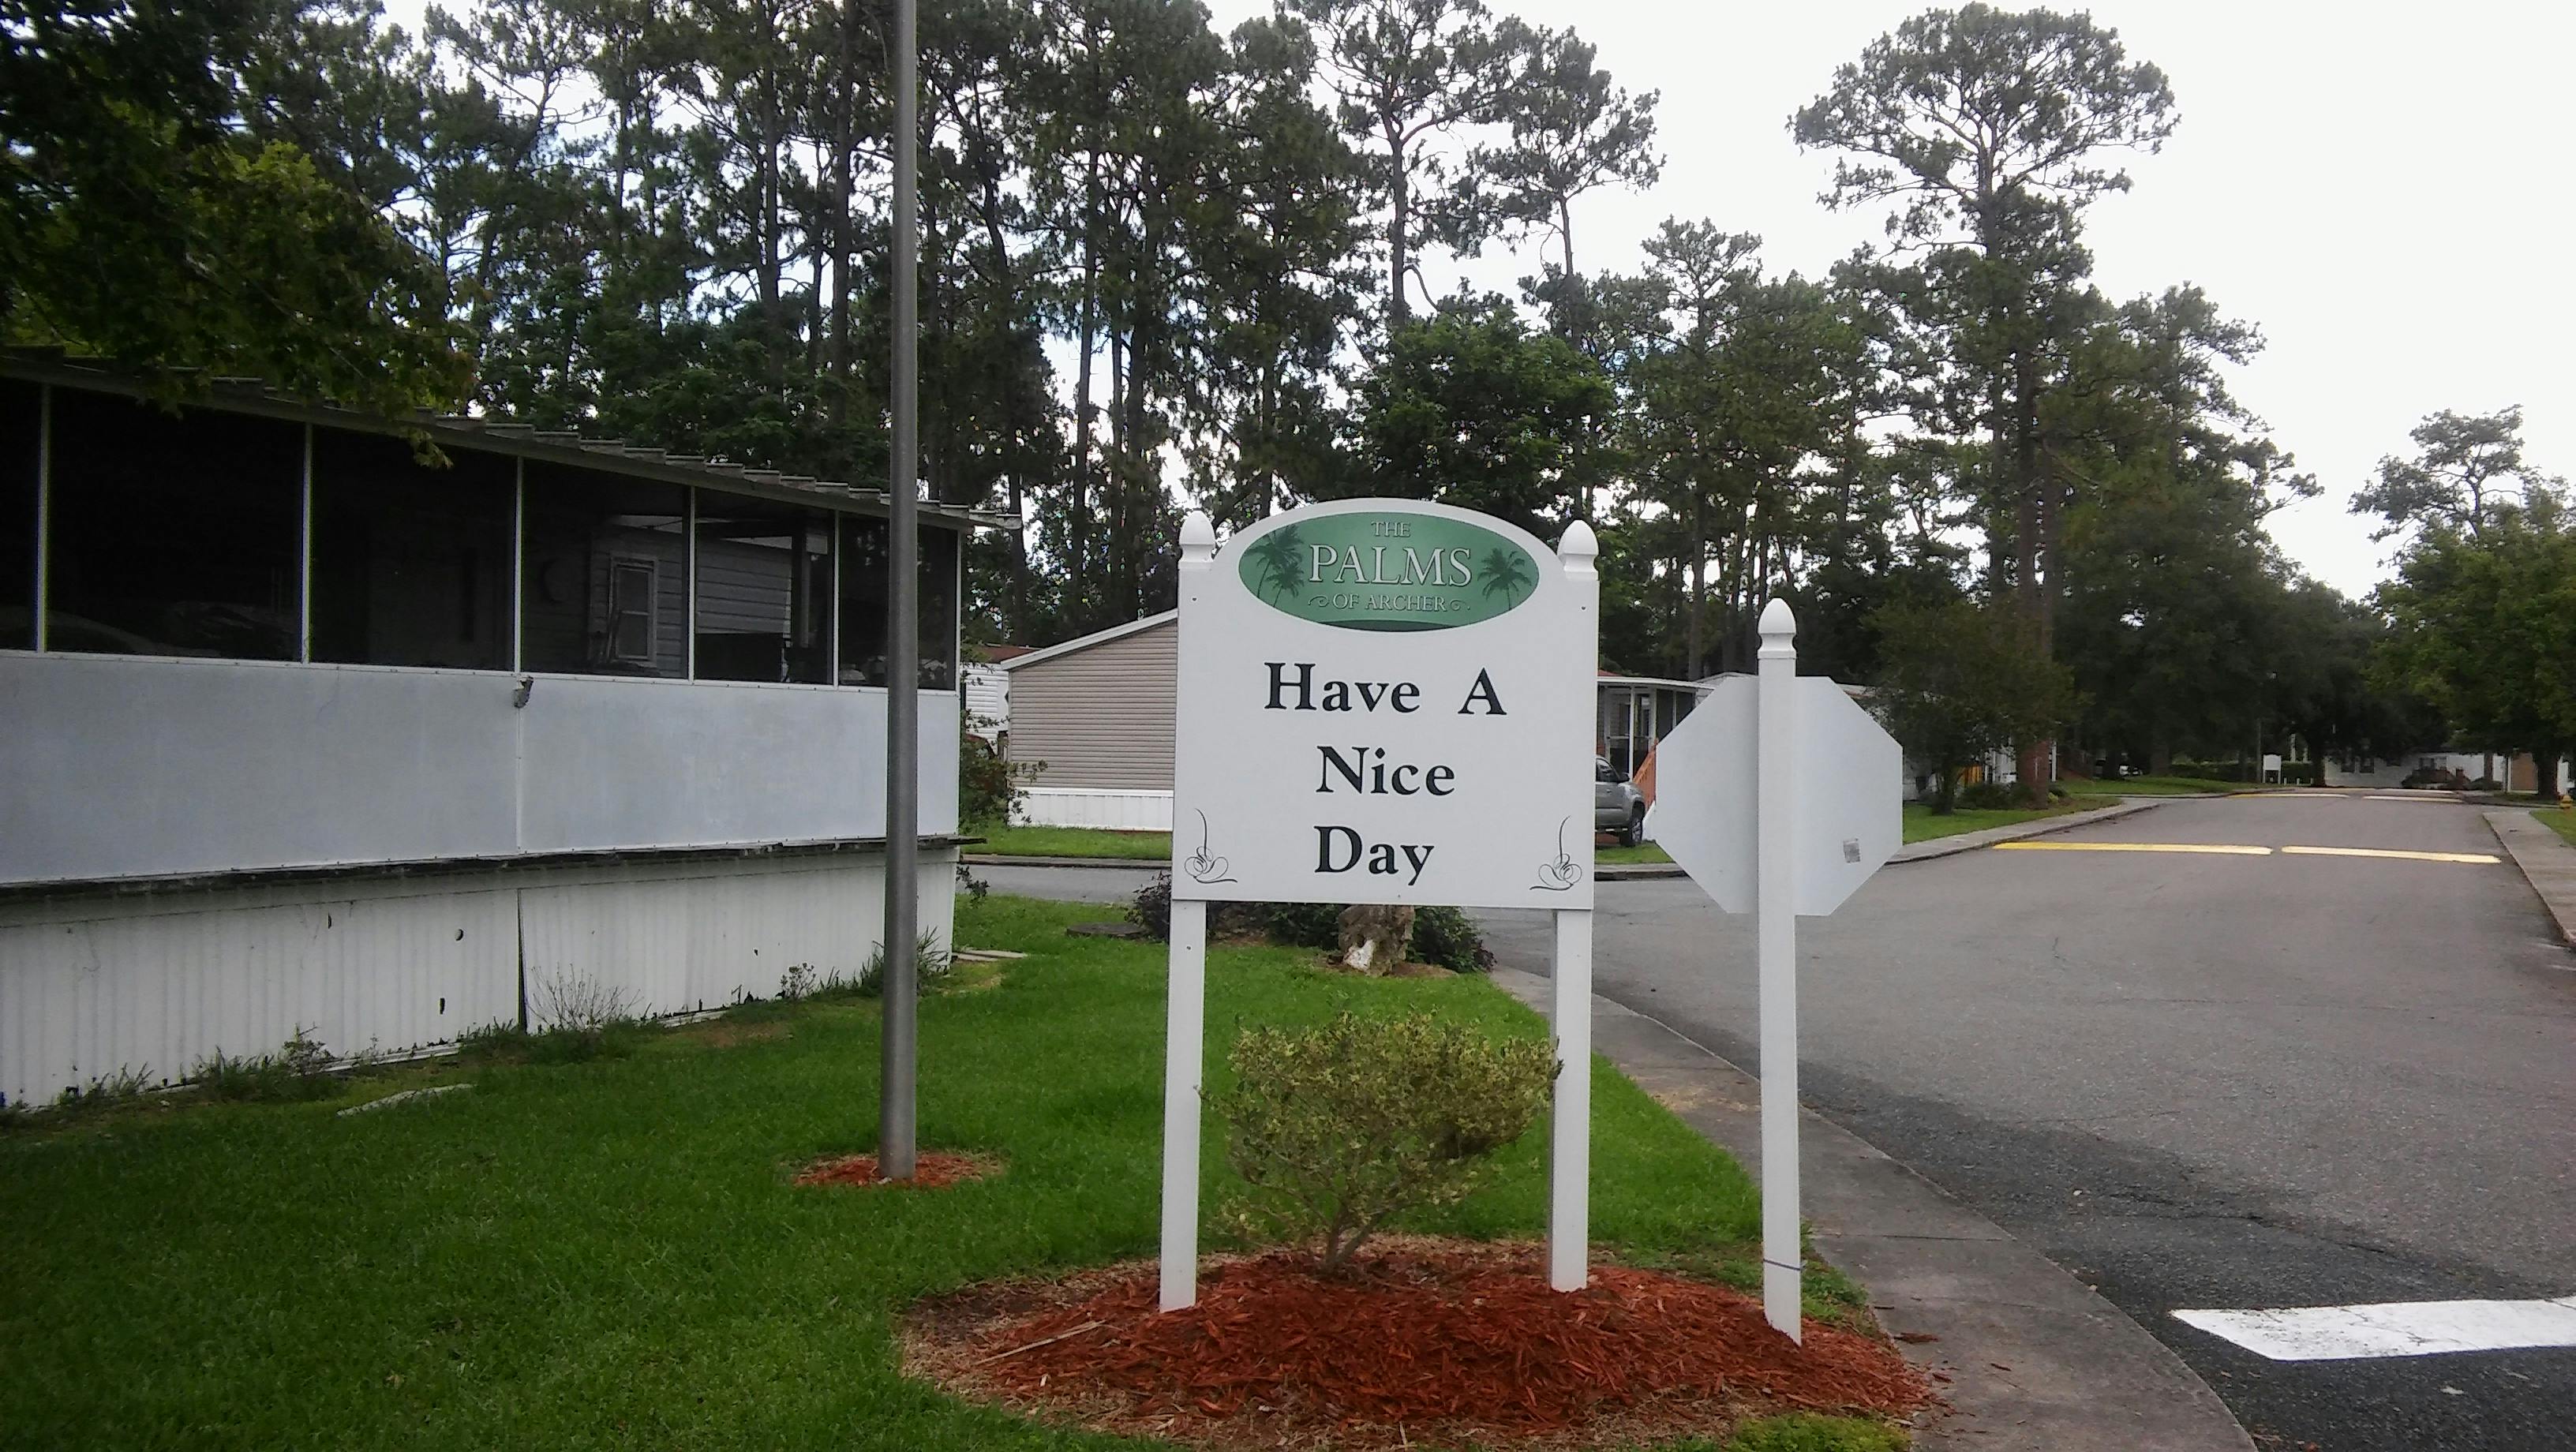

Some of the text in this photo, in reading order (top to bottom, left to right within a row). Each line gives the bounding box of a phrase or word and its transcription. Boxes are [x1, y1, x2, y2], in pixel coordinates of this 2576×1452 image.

[1371, 521, 1411, 538] THE
[1308, 543, 1473, 587] PALMS
[1332, 593, 1447, 612] OF ARCHER
[1264, 661, 1507, 716] Have A
[1315, 745, 1455, 796] Nice
[1313, 825, 1435, 886] Day
